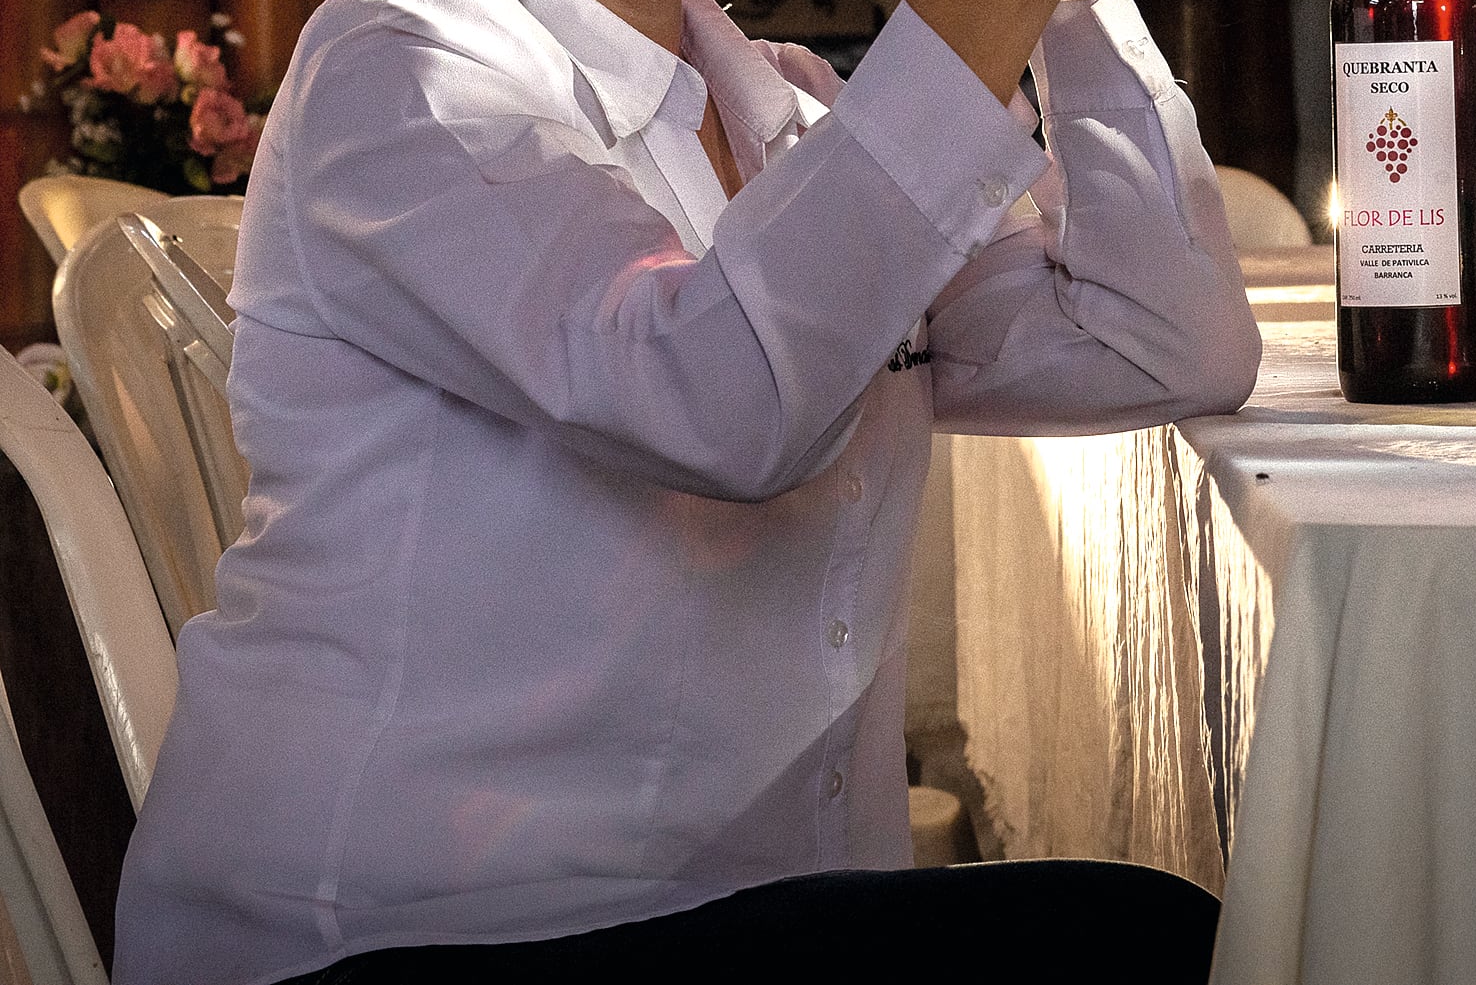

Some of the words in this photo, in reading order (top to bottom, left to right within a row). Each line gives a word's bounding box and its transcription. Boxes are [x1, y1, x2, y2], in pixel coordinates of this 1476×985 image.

[1343, 61, 1438, 77] QUEBRANTA
[1370, 82, 1409, 93] SECO
[1344, 210, 1383, 226] FLOR
[1389, 210, 1413, 226] DE
[1420, 209, 1445, 225] LIS
[1362, 244, 1424, 253] CARRETERIA
